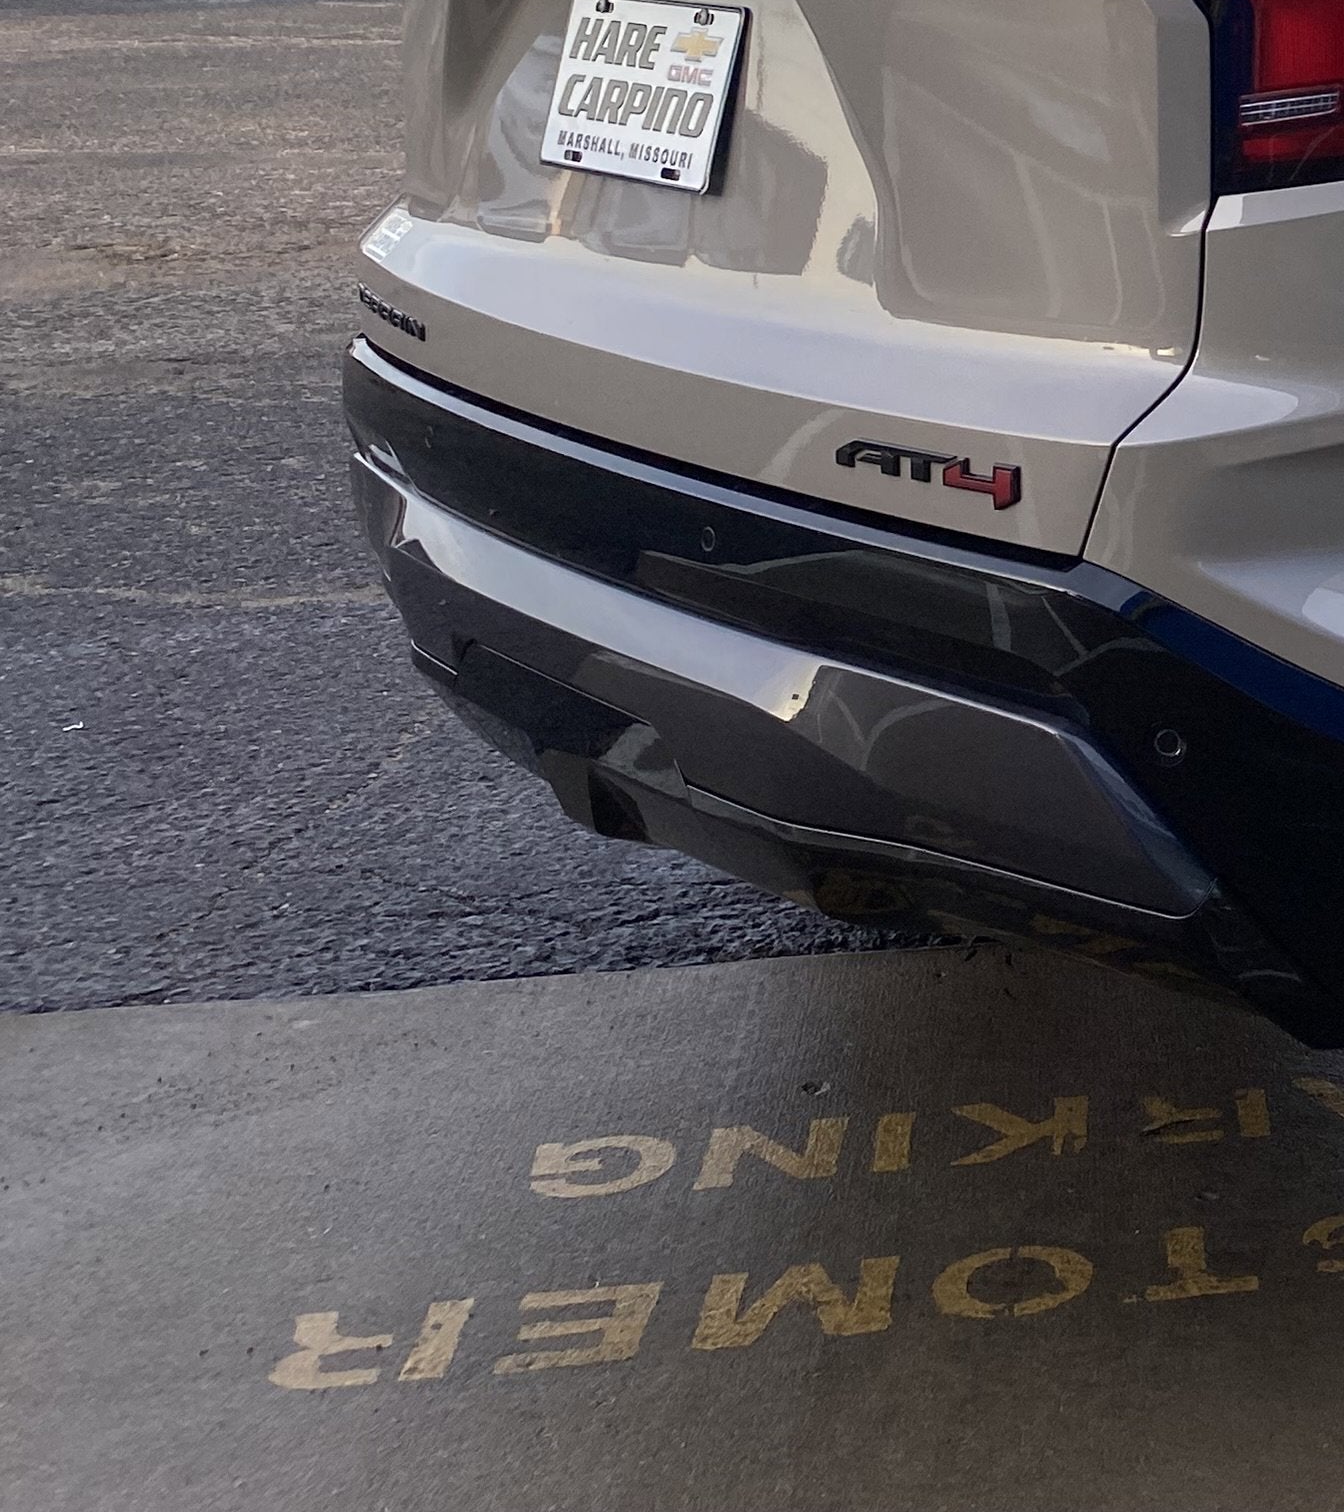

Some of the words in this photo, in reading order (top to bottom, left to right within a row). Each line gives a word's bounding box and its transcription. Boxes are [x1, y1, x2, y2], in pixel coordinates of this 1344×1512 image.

[569, 17, 667, 71] HARE
[667, 64, 714, 86] GMC
[557, 74, 714, 139] CARPINO
[557, 130, 625, 161] MARSHALL,
[628, 142, 694, 170] MISSOURI
[836, 438, 1022, 511] AT4
